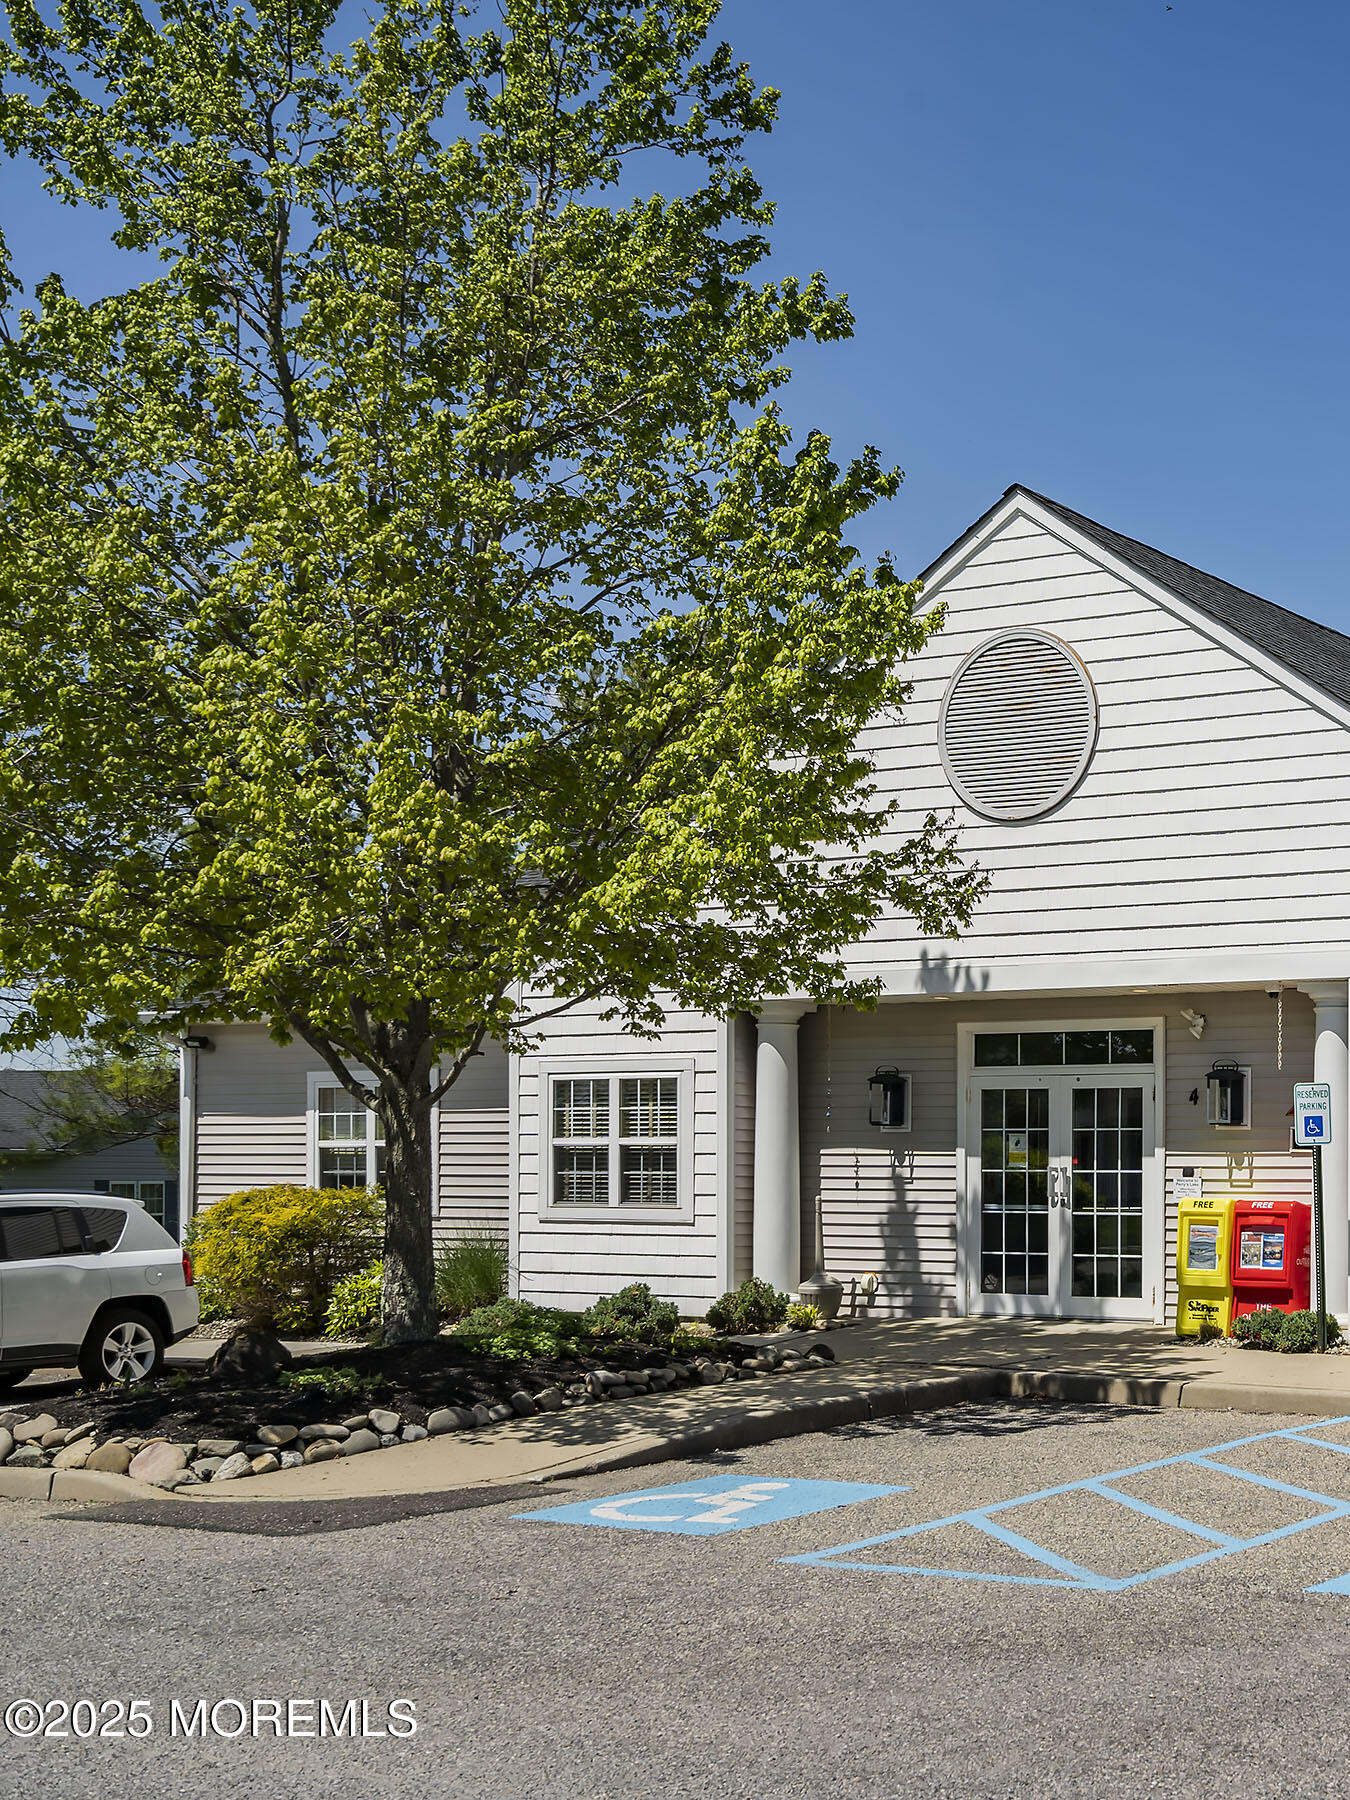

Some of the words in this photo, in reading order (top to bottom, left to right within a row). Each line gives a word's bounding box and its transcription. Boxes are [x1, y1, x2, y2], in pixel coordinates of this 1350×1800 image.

[1189, 1088, 1199, 1105] 4
[1297, 1090, 1328, 1098] RESERVED
[1300, 1102, 1327, 1110] PARKING
